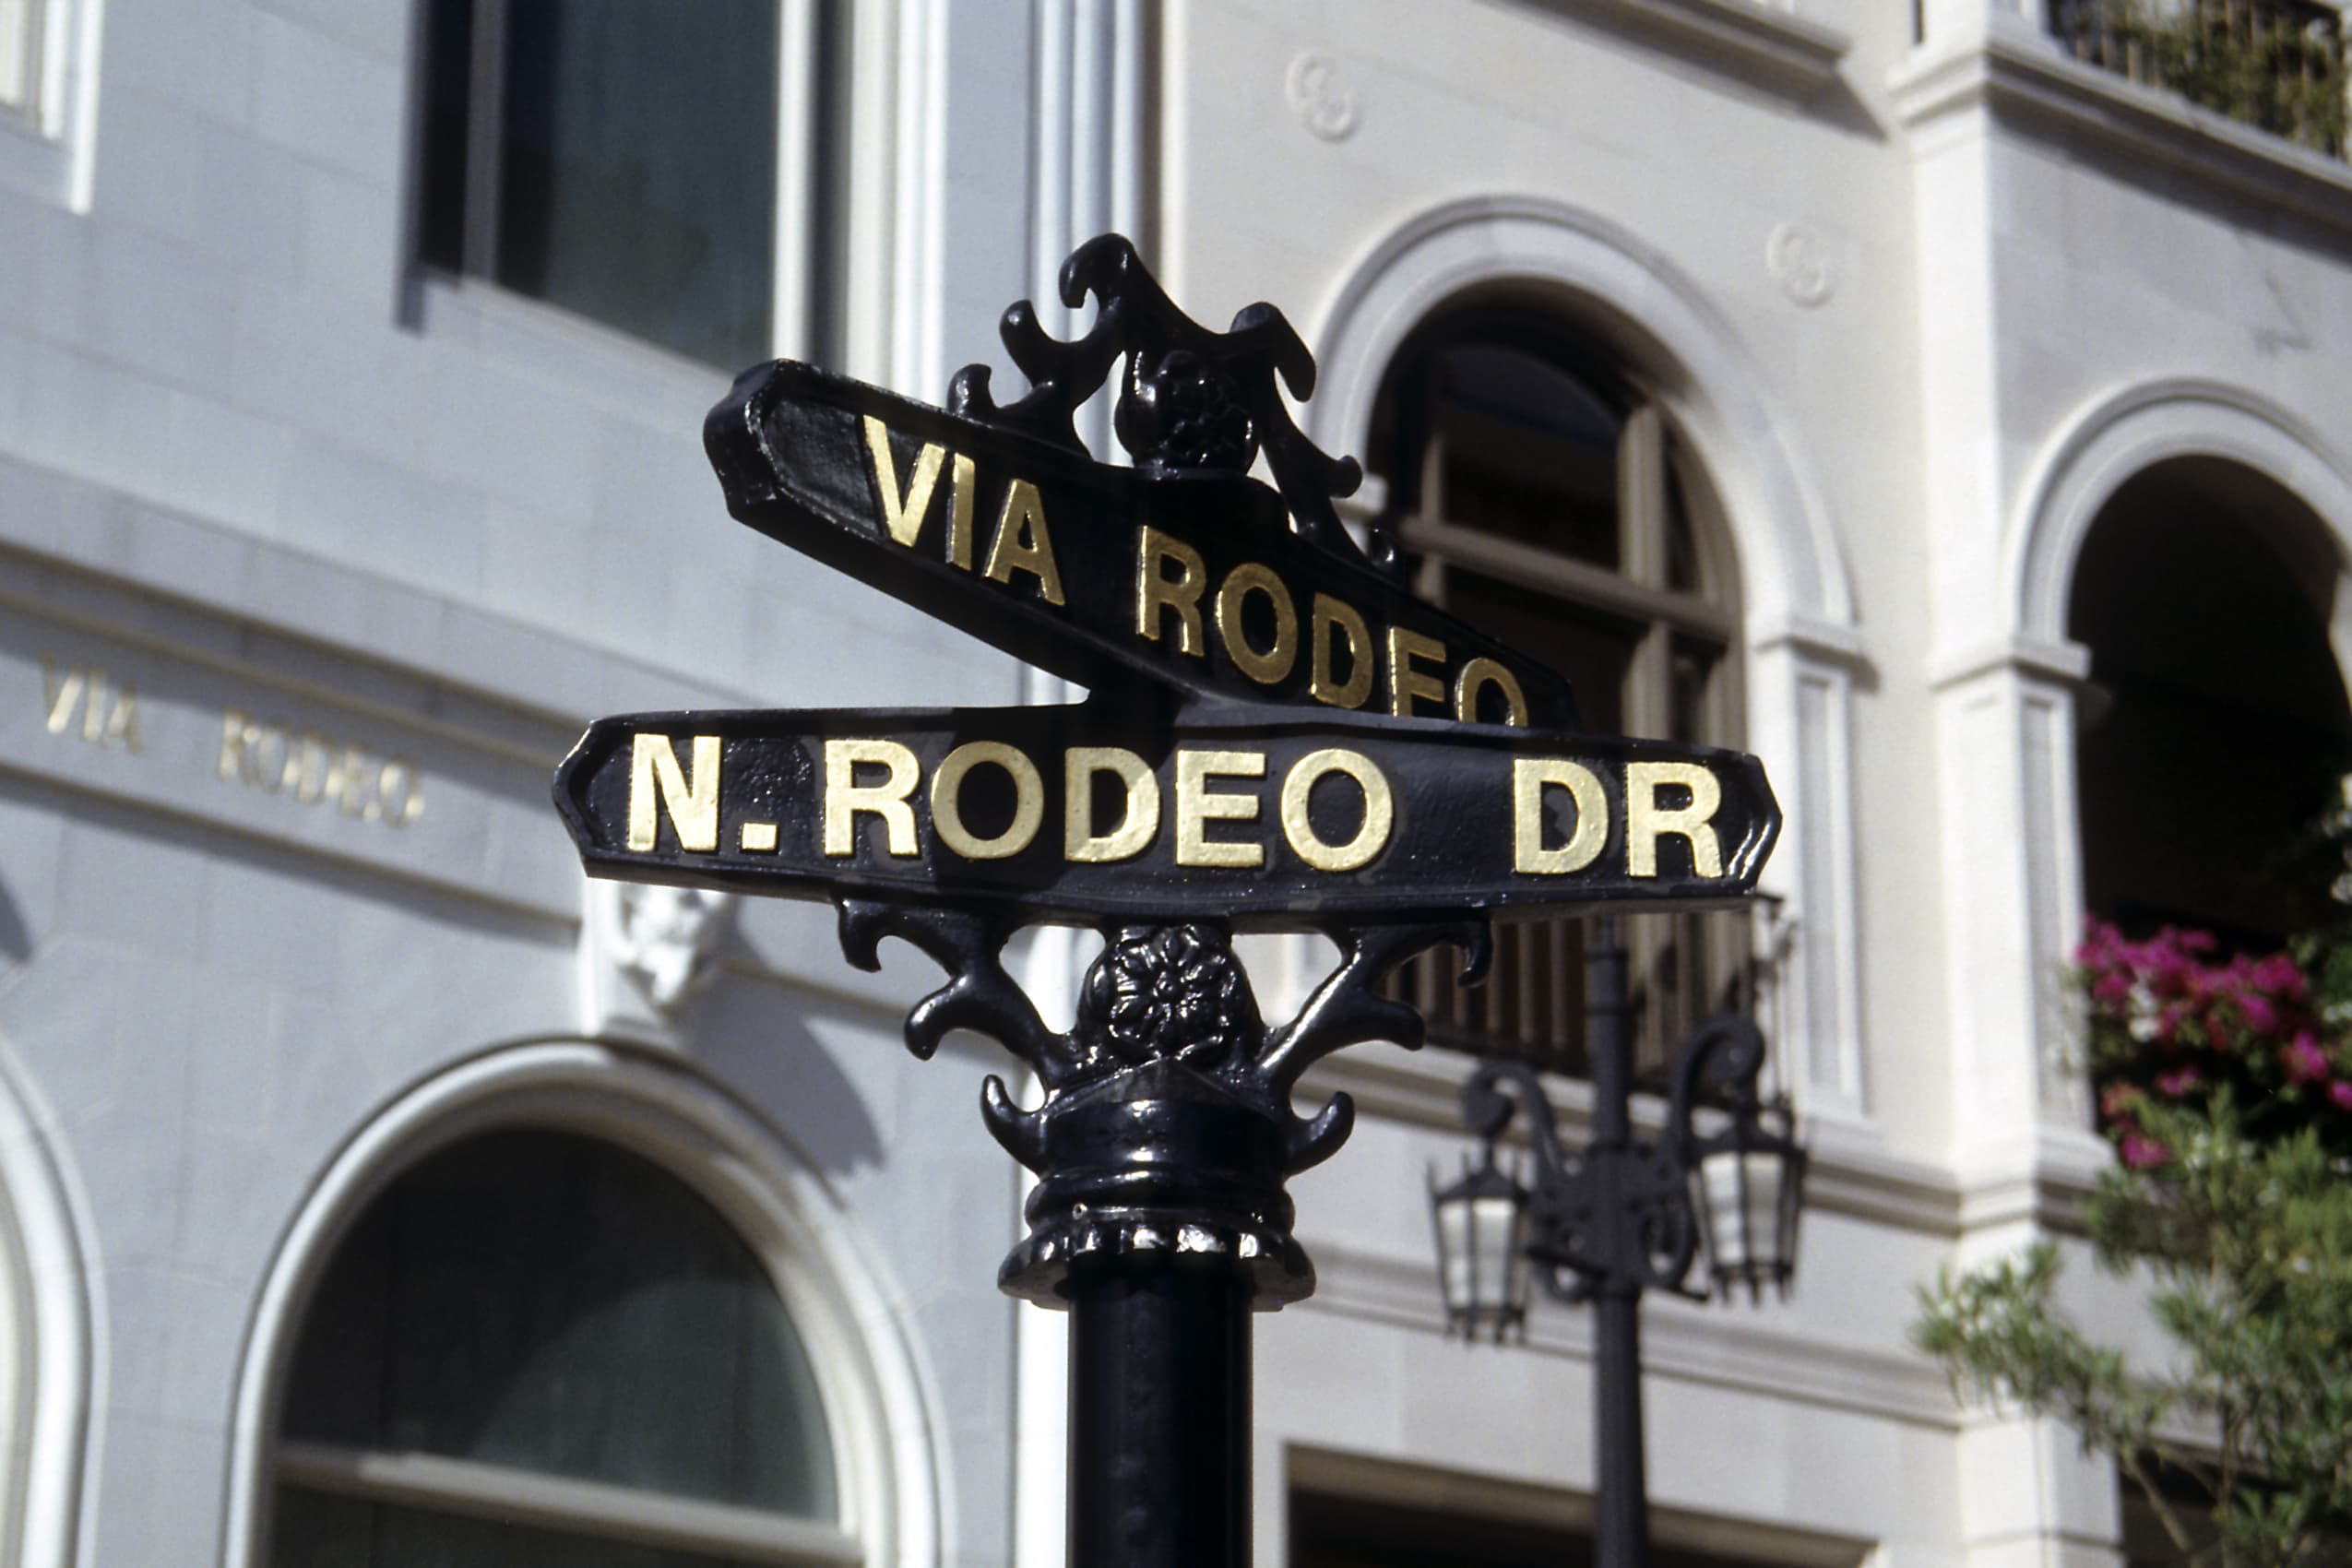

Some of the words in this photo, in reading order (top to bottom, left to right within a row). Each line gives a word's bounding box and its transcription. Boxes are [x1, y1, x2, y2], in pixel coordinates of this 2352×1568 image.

[862, 413, 1066, 607] VIA
[1138, 525, 1528, 726] RODEO
[40, 652, 142, 754] VIA
[218, 707, 426, 827] RODEO
[628, 733, 777, 851] N.
[824, 739, 1393, 872] RODEO
[1514, 758, 1723, 878] DR
